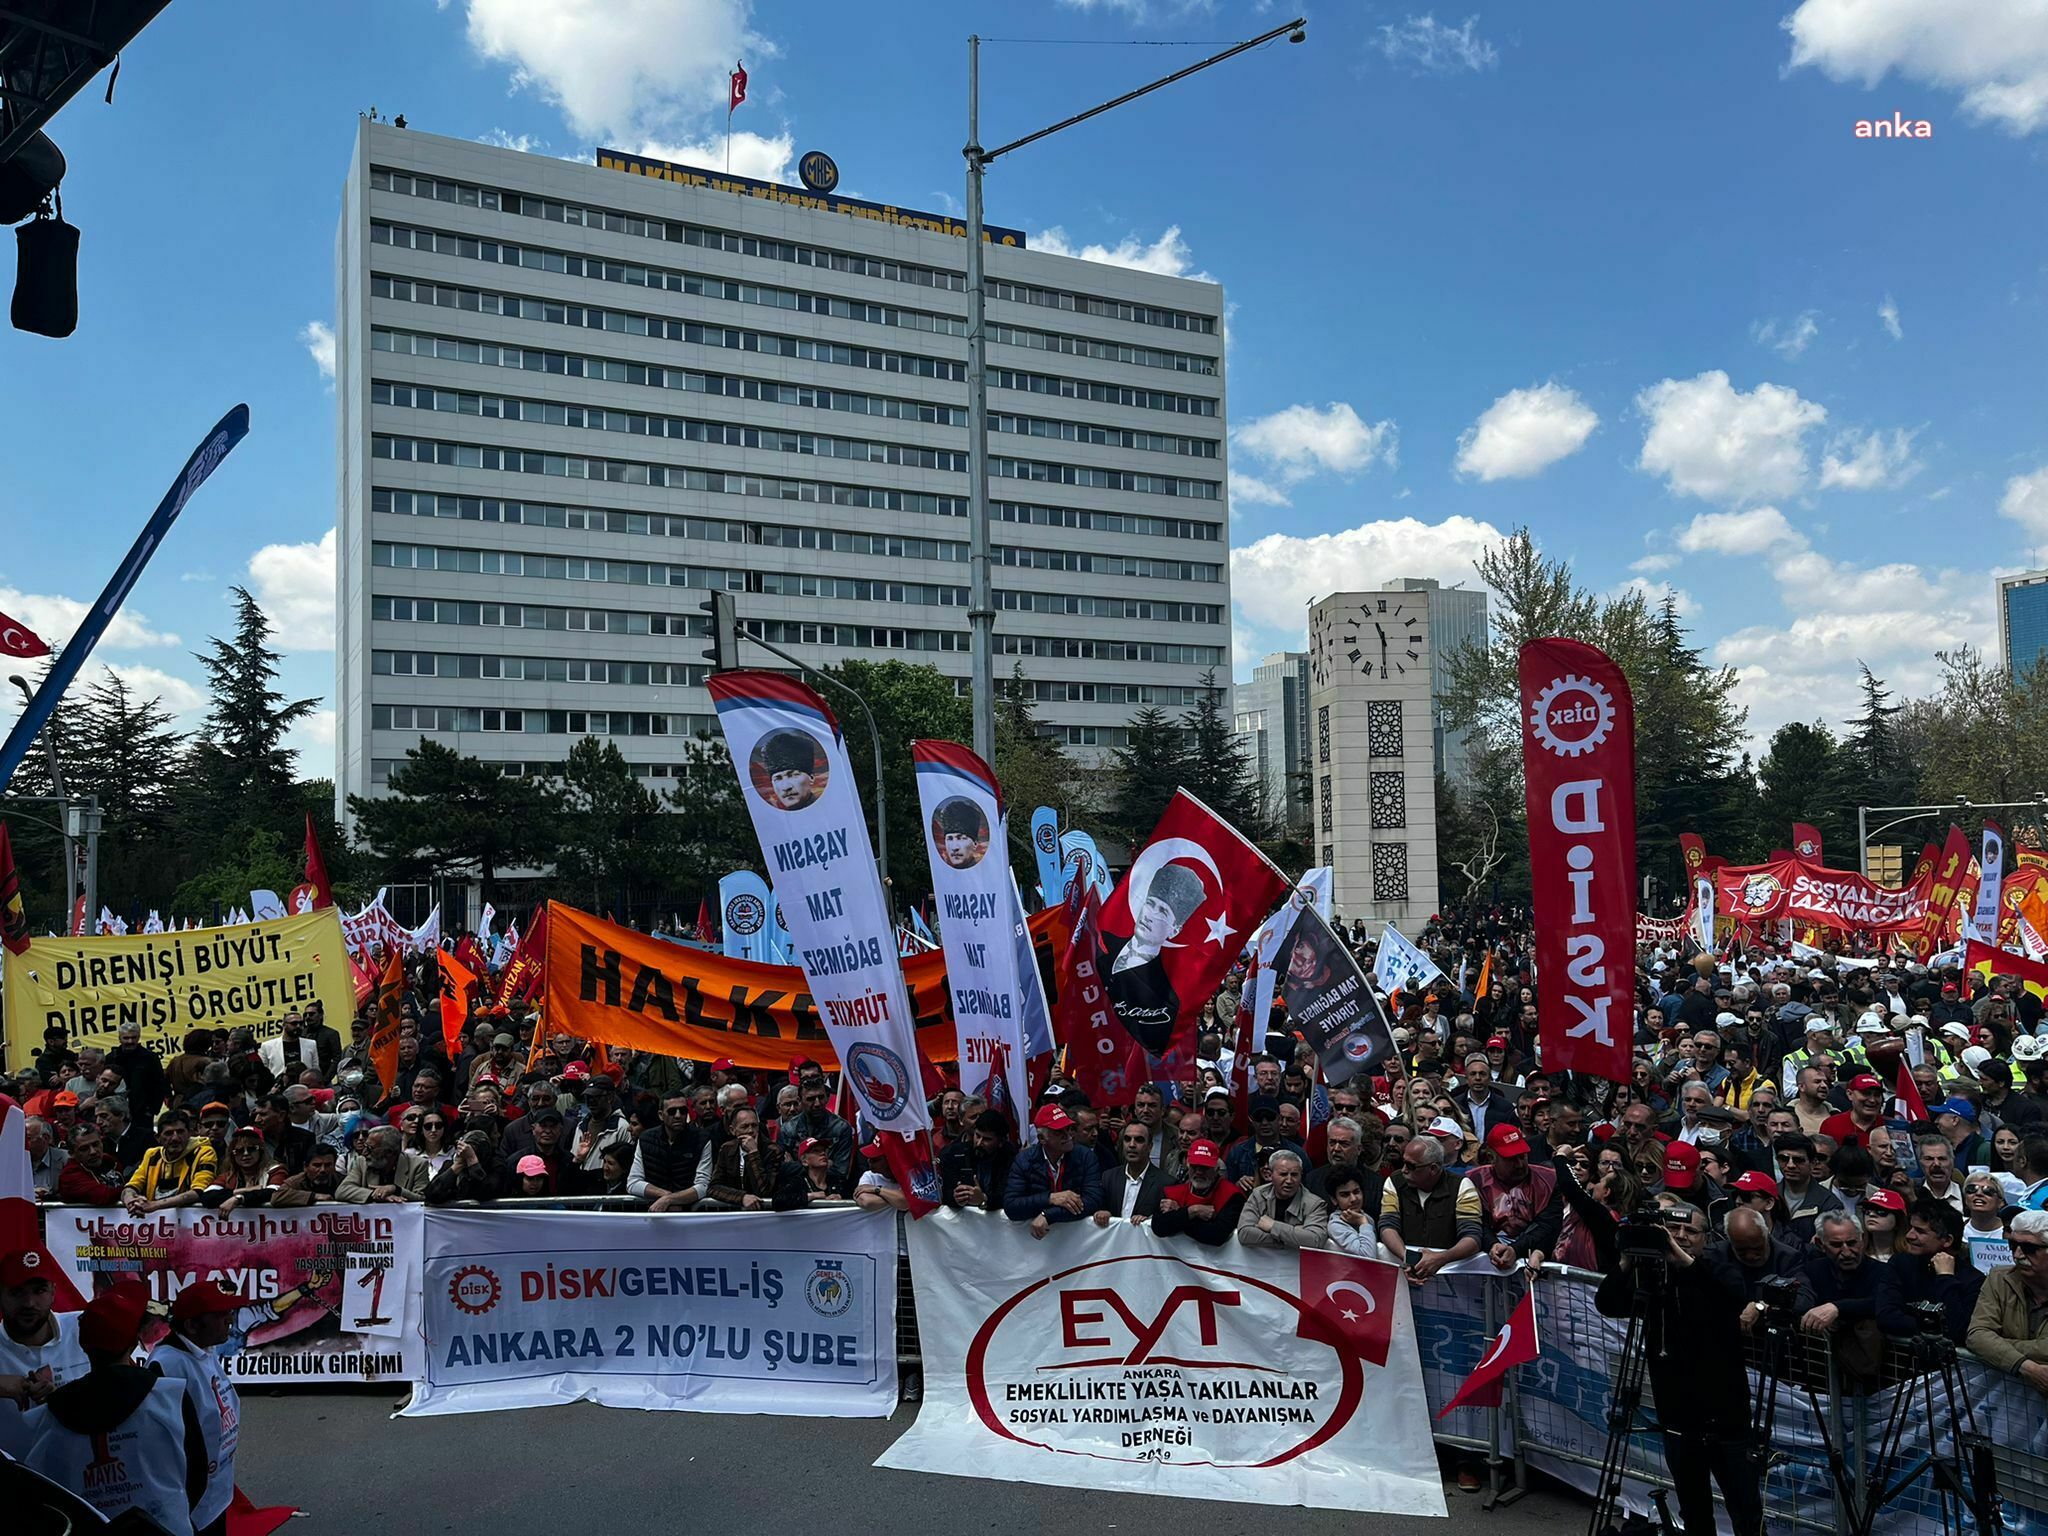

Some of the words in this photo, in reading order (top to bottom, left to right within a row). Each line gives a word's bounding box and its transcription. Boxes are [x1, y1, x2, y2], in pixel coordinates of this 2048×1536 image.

[56, 939, 185, 990] DİRENİŞİ
[194, 928, 291, 974] BÜYÜT,
[188, 972, 315, 1019] ÖRGÜTLE!
[1977, 1253, 2013, 1263] OTOPARÇ
[1984, 1244, 2011, 1252] ANADO
[460, 1282, 491, 1296] DİSK
[520, 1260, 784, 1308] DİSK/GENEL-İŞ
[1059, 1285, 1242, 1366] EYT
[445, 1327, 604, 1368] ANKARA
[615, 1325, 635, 1357] 2
[762, 1329, 858, 1371] ŞUBE
[236, 1350, 325, 1376] ÖZGÜRLÜK
[328, 1350, 403, 1377] GİRİŞİMİ
[1123, 1368, 1182, 1380] ANKARA
[1006, 1377, 1126, 1402] EMEKLİLİKTE
[1131, 1378, 1185, 1403] YAŞA
[1187, 1380, 1319, 1401] TAKILANLAR
[1009, 1407, 1069, 1425] SOSYAL
[1071, 1406, 1189, 1425] YARDIMLAŞMA
[1192, 1409, 1210, 1424] ve
[1213, 1406, 1315, 1427] DAYANIŞMA
[1121, 1426, 1193, 1449] DERNEĞİ
